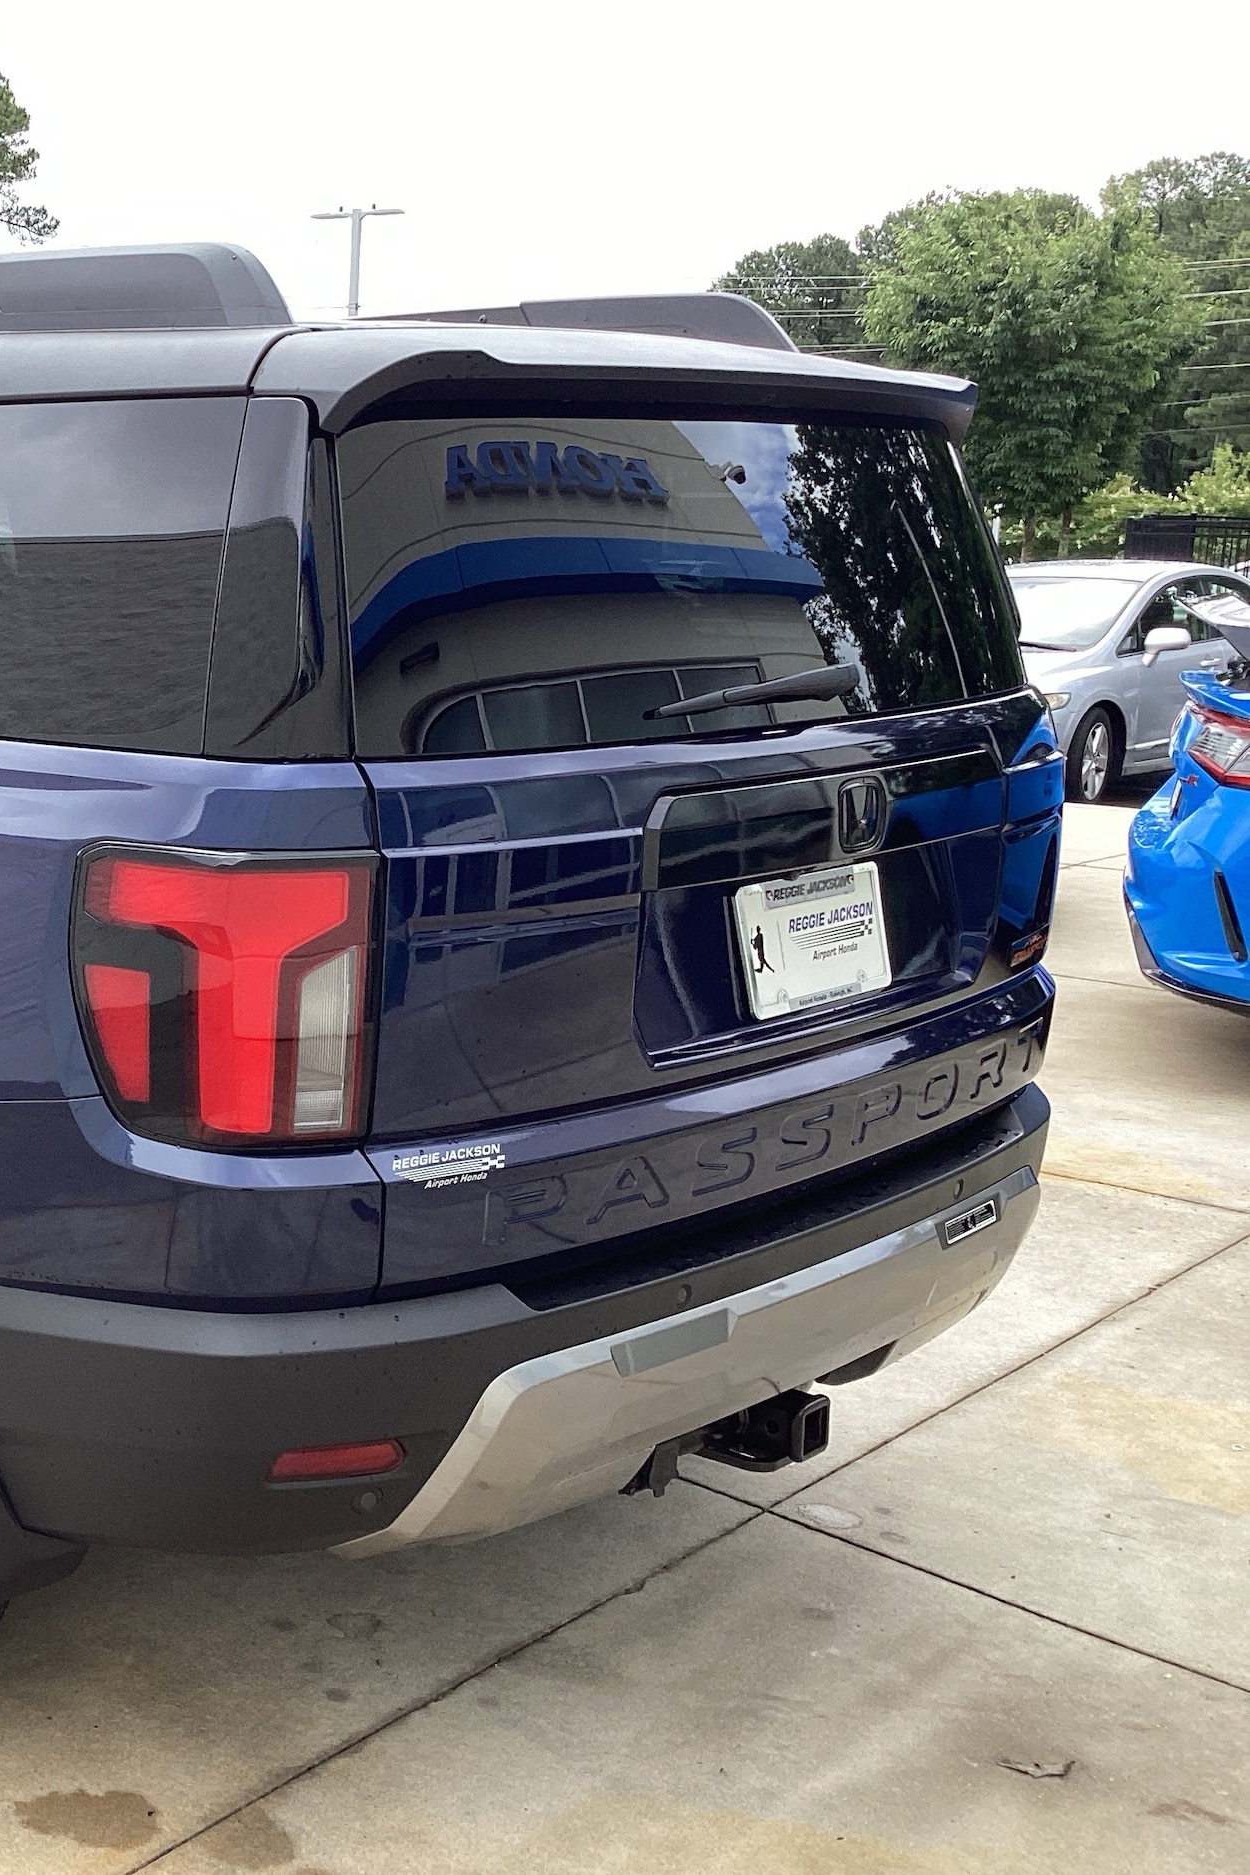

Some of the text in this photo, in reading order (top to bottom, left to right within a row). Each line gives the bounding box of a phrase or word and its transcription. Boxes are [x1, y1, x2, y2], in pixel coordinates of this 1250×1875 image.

[773, 884, 806, 901] REGGIE
[789, 902, 873, 933] REGGIE JACKSON
[813, 941, 858, 961] Airport Honda
[483, 1017, 1043, 1245] PASSPORT
[392, 1143, 501, 1171] REGGIE JACKSON
[424, 1171, 488, 1190] Airport Honda
